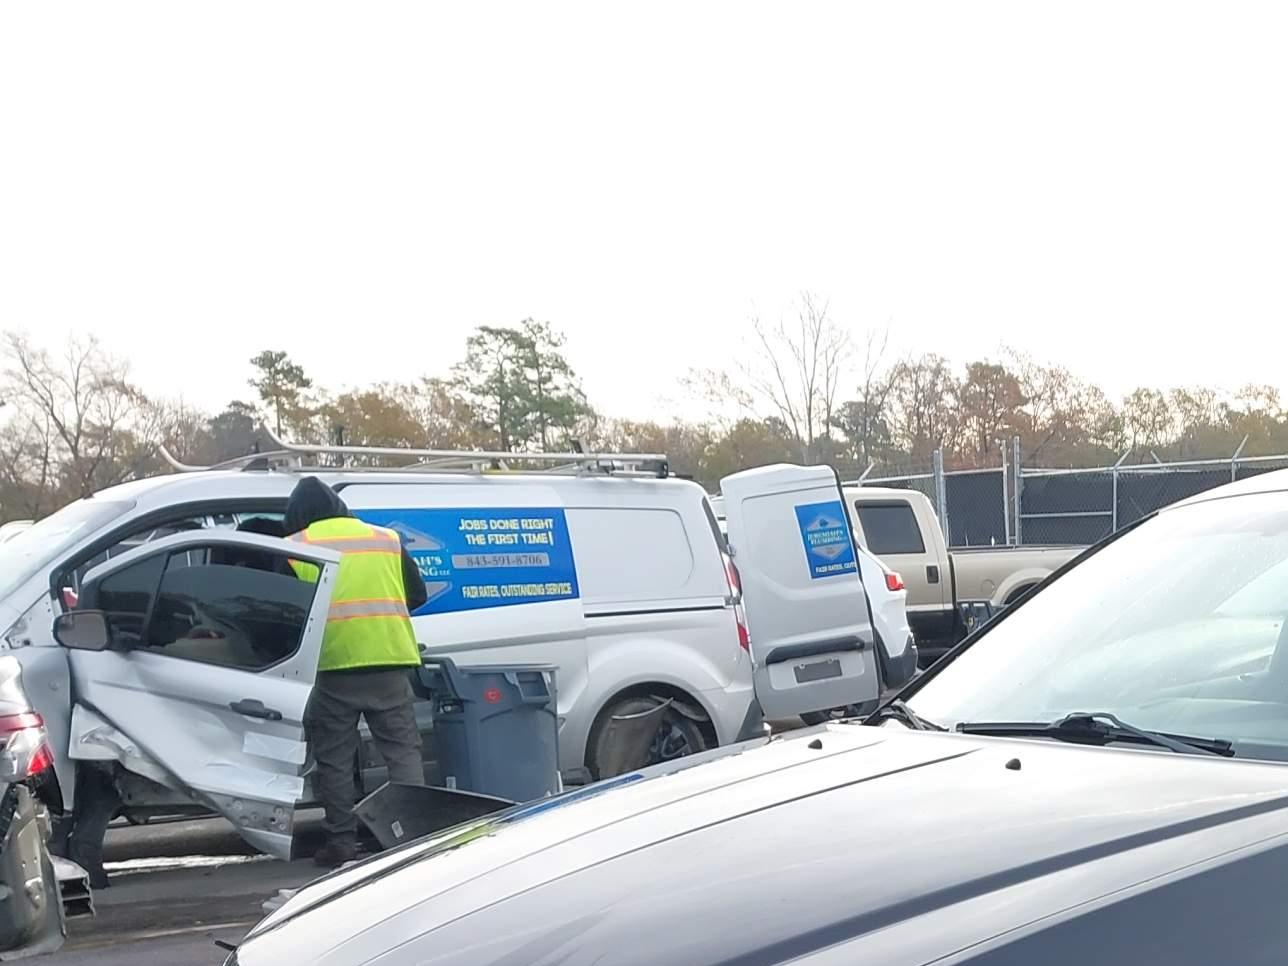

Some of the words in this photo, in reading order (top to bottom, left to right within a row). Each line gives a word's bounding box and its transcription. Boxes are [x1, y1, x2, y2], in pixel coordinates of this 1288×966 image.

[459, 518, 488, 530] JOBS
[489, 518, 519, 530] DONE
[520, 518, 554, 530] RIGHT
[465, 533, 486, 545] THE
[487, 532, 519, 545] FIRST
[462, 586, 480, 599] FAIR
[501, 583, 545, 597] OUTSTANDING
[545, 582, 573, 595] SERVICE
